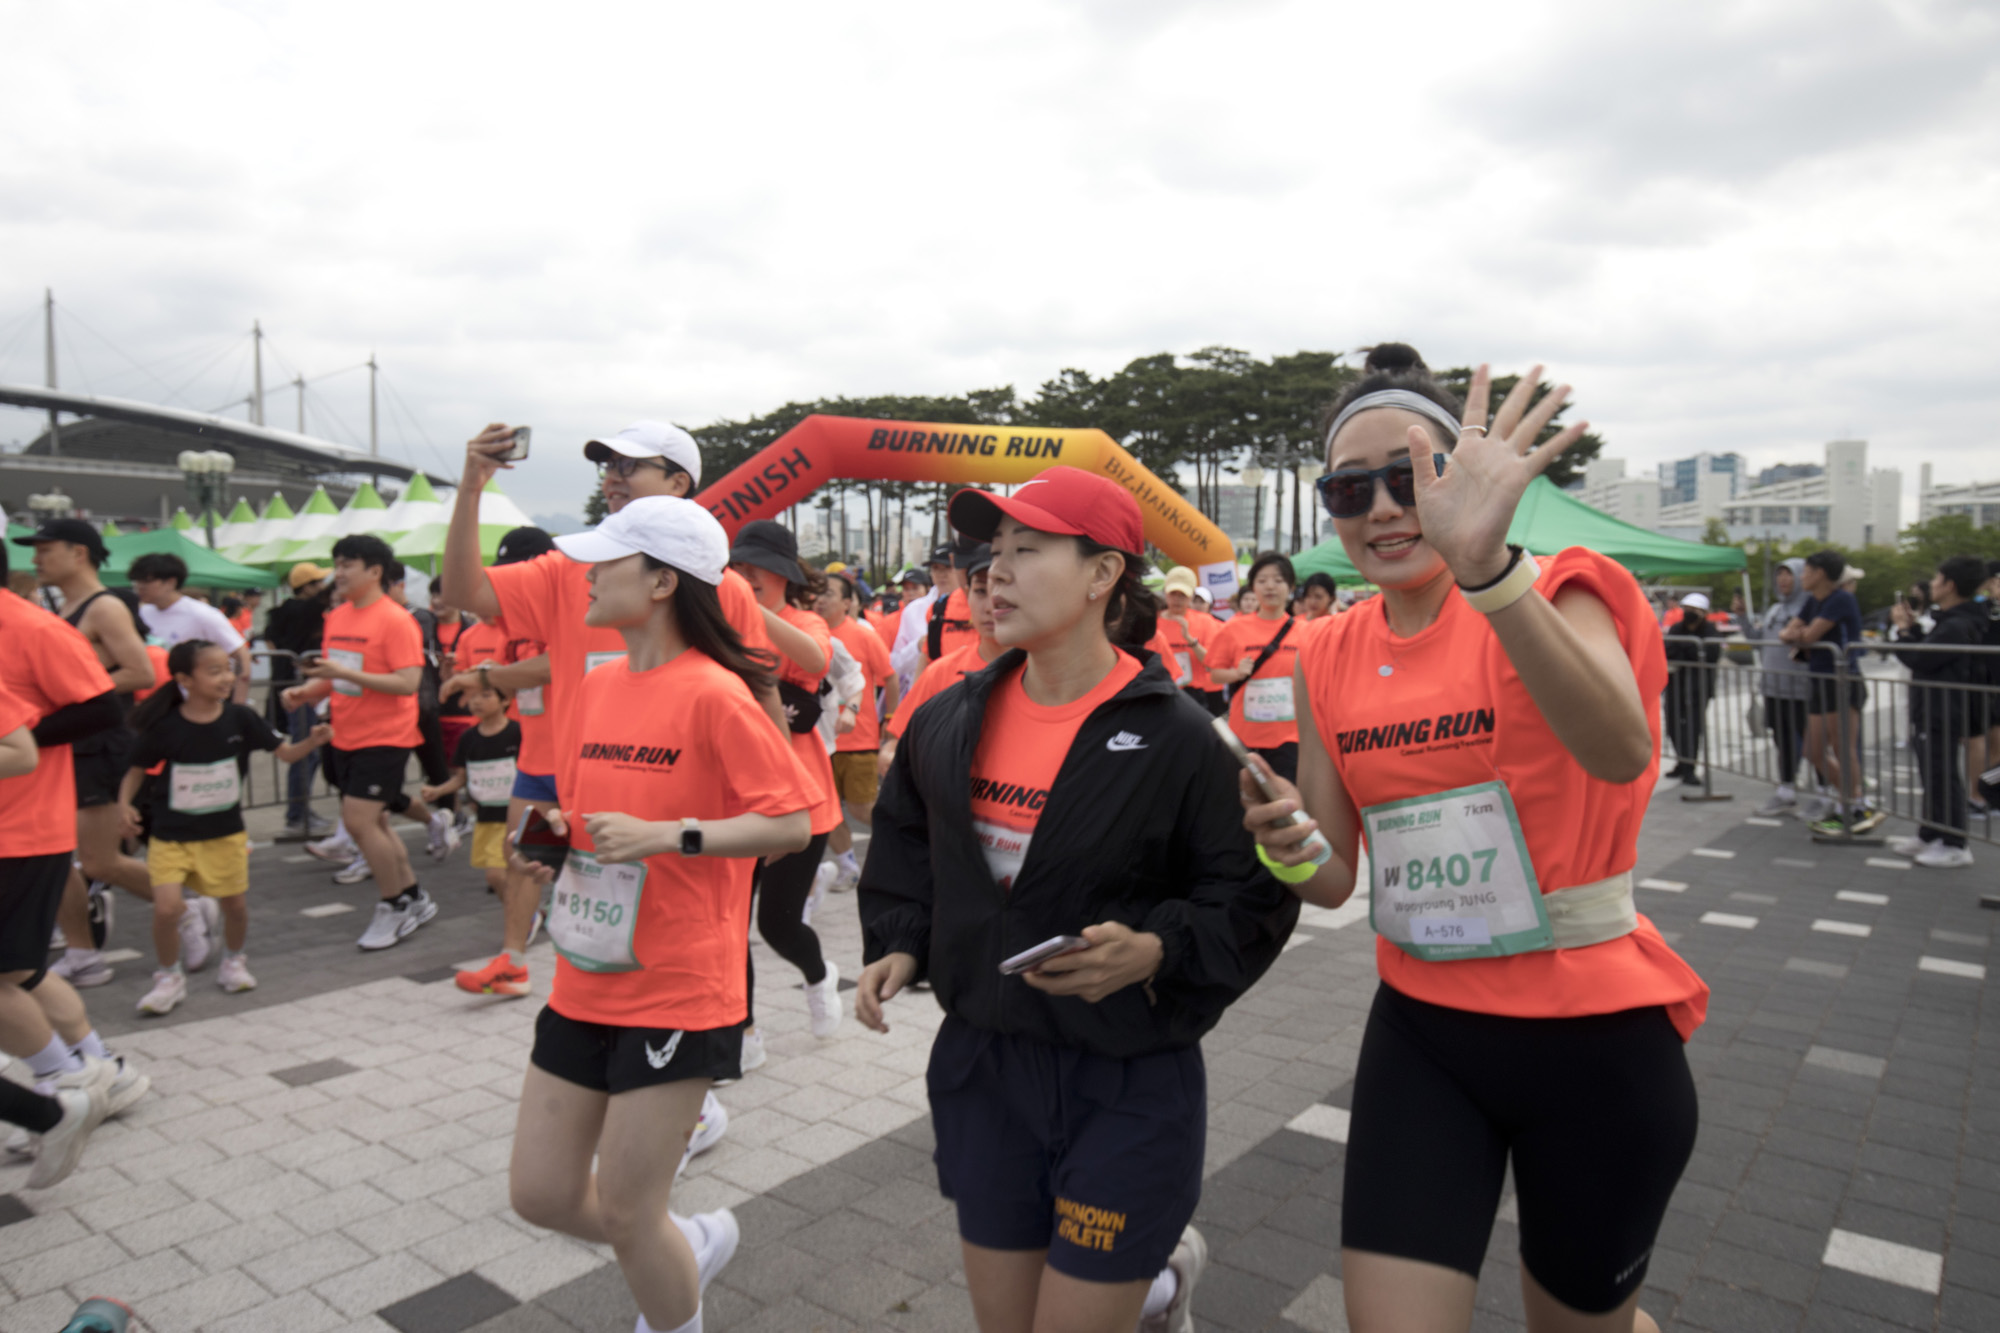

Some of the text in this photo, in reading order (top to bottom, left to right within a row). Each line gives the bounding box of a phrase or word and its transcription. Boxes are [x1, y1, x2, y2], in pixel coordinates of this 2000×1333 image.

[868, 429, 1064, 458] BURNING RUN
[1433, 707, 1495, 741] RUN
[1114, 730, 1143, 746] NIKE
[633, 746, 682, 766] RUN
[1417, 808, 1443, 826] RUN
[1463, 803, 1494, 817] 7km
[1384, 847, 1498, 891] W 8407
[569, 893, 624, 928] 8150
[1394, 891, 1496, 915] Wooyoung JUNG
[1424, 925, 1465, 939] A-576
